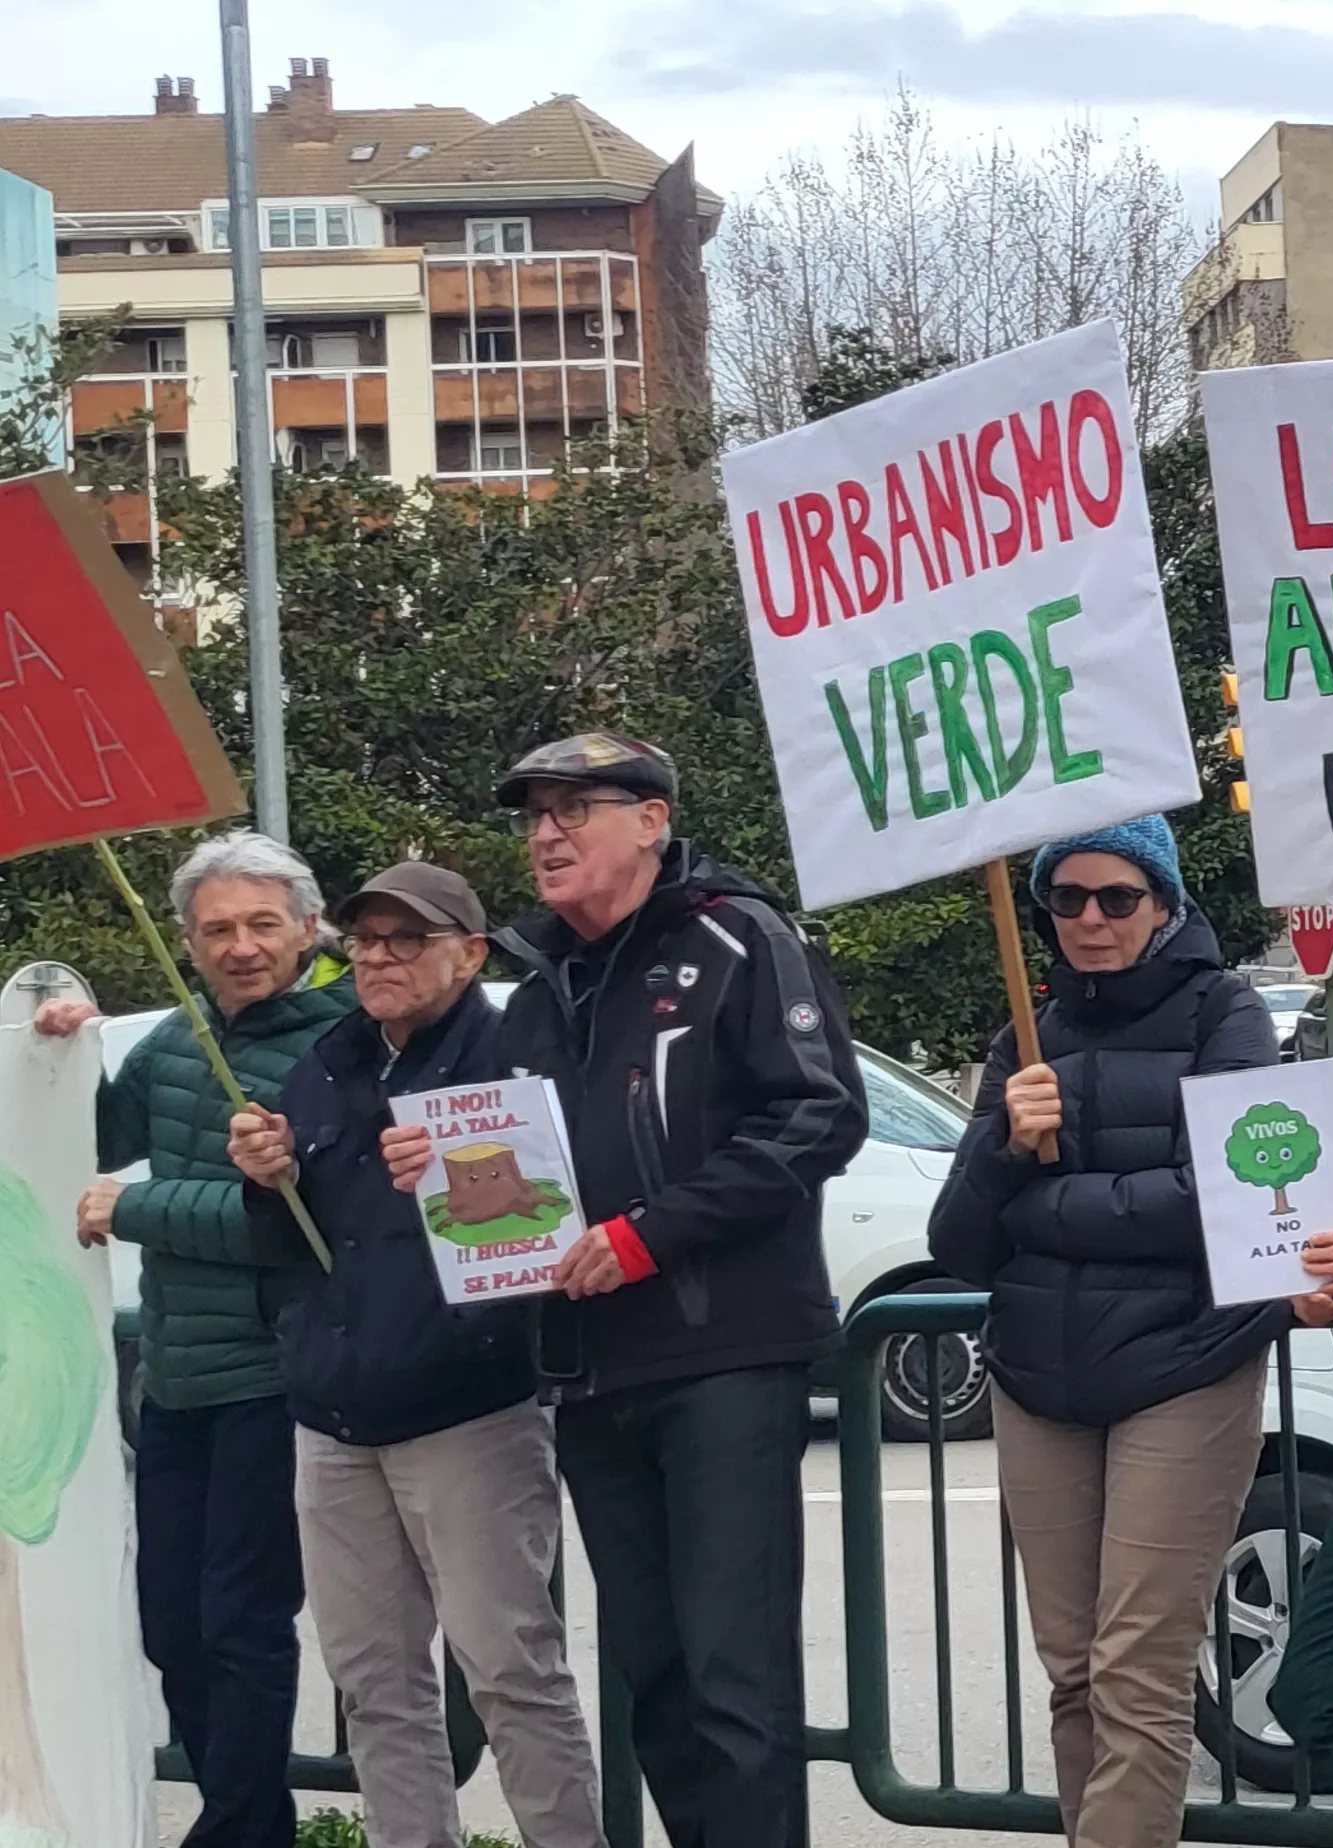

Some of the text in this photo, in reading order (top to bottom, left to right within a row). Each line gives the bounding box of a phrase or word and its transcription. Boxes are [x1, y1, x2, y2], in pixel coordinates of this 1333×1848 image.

[746, 389, 1123, 638] URBANISMO
[824, 593, 1104, 833] VERDE
[435, 1121, 463, 1139] LA
[1244, 1119, 1298, 1140] VIVOS
[1276, 1220, 1301, 1233] NO
[476, 1234, 558, 1262] HUESCA
[1250, 1240, 1312, 1259] A LA TA
[463, 1264, 560, 1294] SE PLANT
